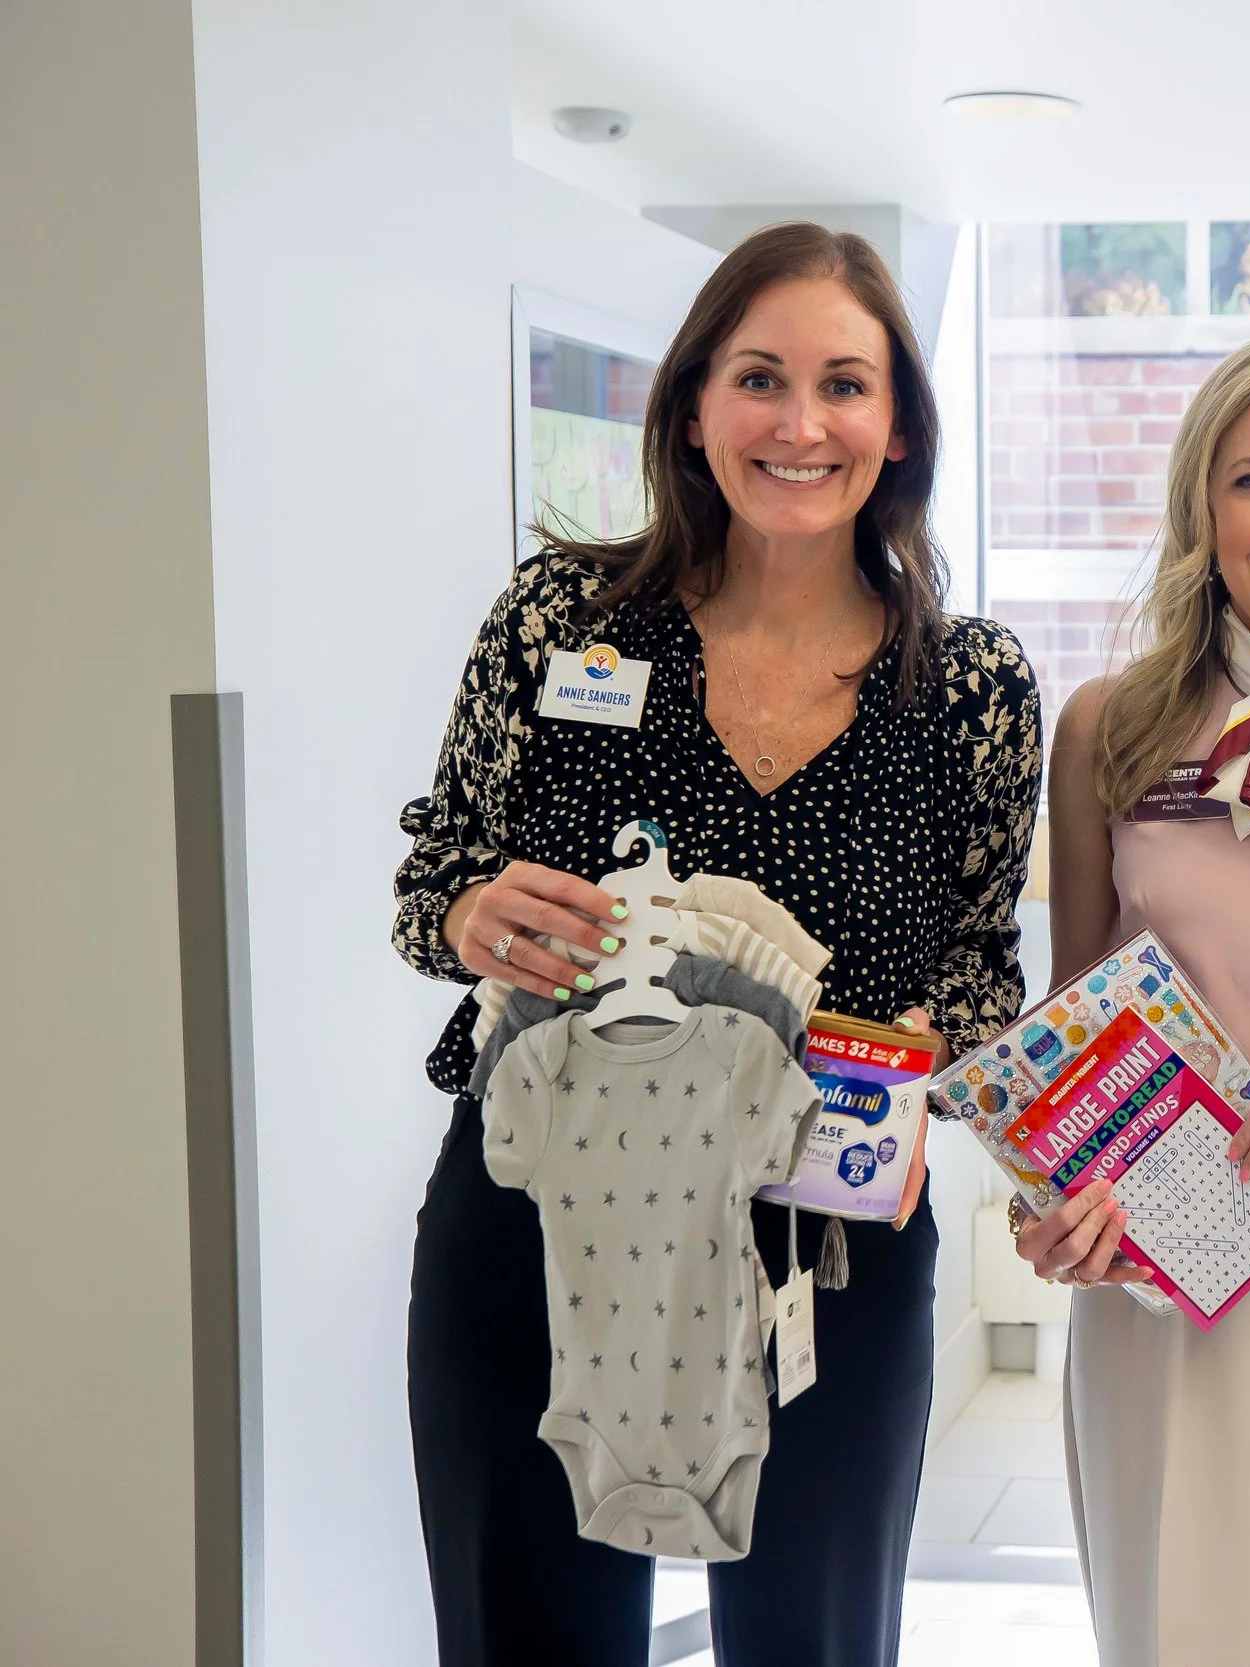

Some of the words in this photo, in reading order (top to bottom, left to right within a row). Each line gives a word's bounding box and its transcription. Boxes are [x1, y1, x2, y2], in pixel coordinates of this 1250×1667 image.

[557, 686, 586, 701] ANNIE
[588, 689, 630, 706] SANDERS
[1166, 768, 1202, 778] CENTR
[1142, 792, 1170, 802] Leanne
[808, 1034, 846, 1054] AKES
[848, 1040, 870, 1058] 32
[811, 1079, 884, 1112] nfamil
[1032, 1092, 1107, 1168] LARGE
[1097, 1036, 1161, 1104] PRINT
[1056, 1061, 1177, 1184] EASY-TO-READ
[1091, 1094, 1178, 1182] WORD-FINDS
[1126, 1138, 1150, 1162] VOLUME
[1148, 1129, 1159, 1140] 154
[1186, 1133, 1211, 1158] FUN
[849, 1165, 865, 1178] 24
[1145, 1150, 1175, 1181] WORD
[1145, 1158, 1188, 1201] SOLVE
[1233, 1163, 1242, 1223] RINT
[1130, 1210, 1171, 1218] EAD
[1159, 1240, 1236, 1250] LARGE
